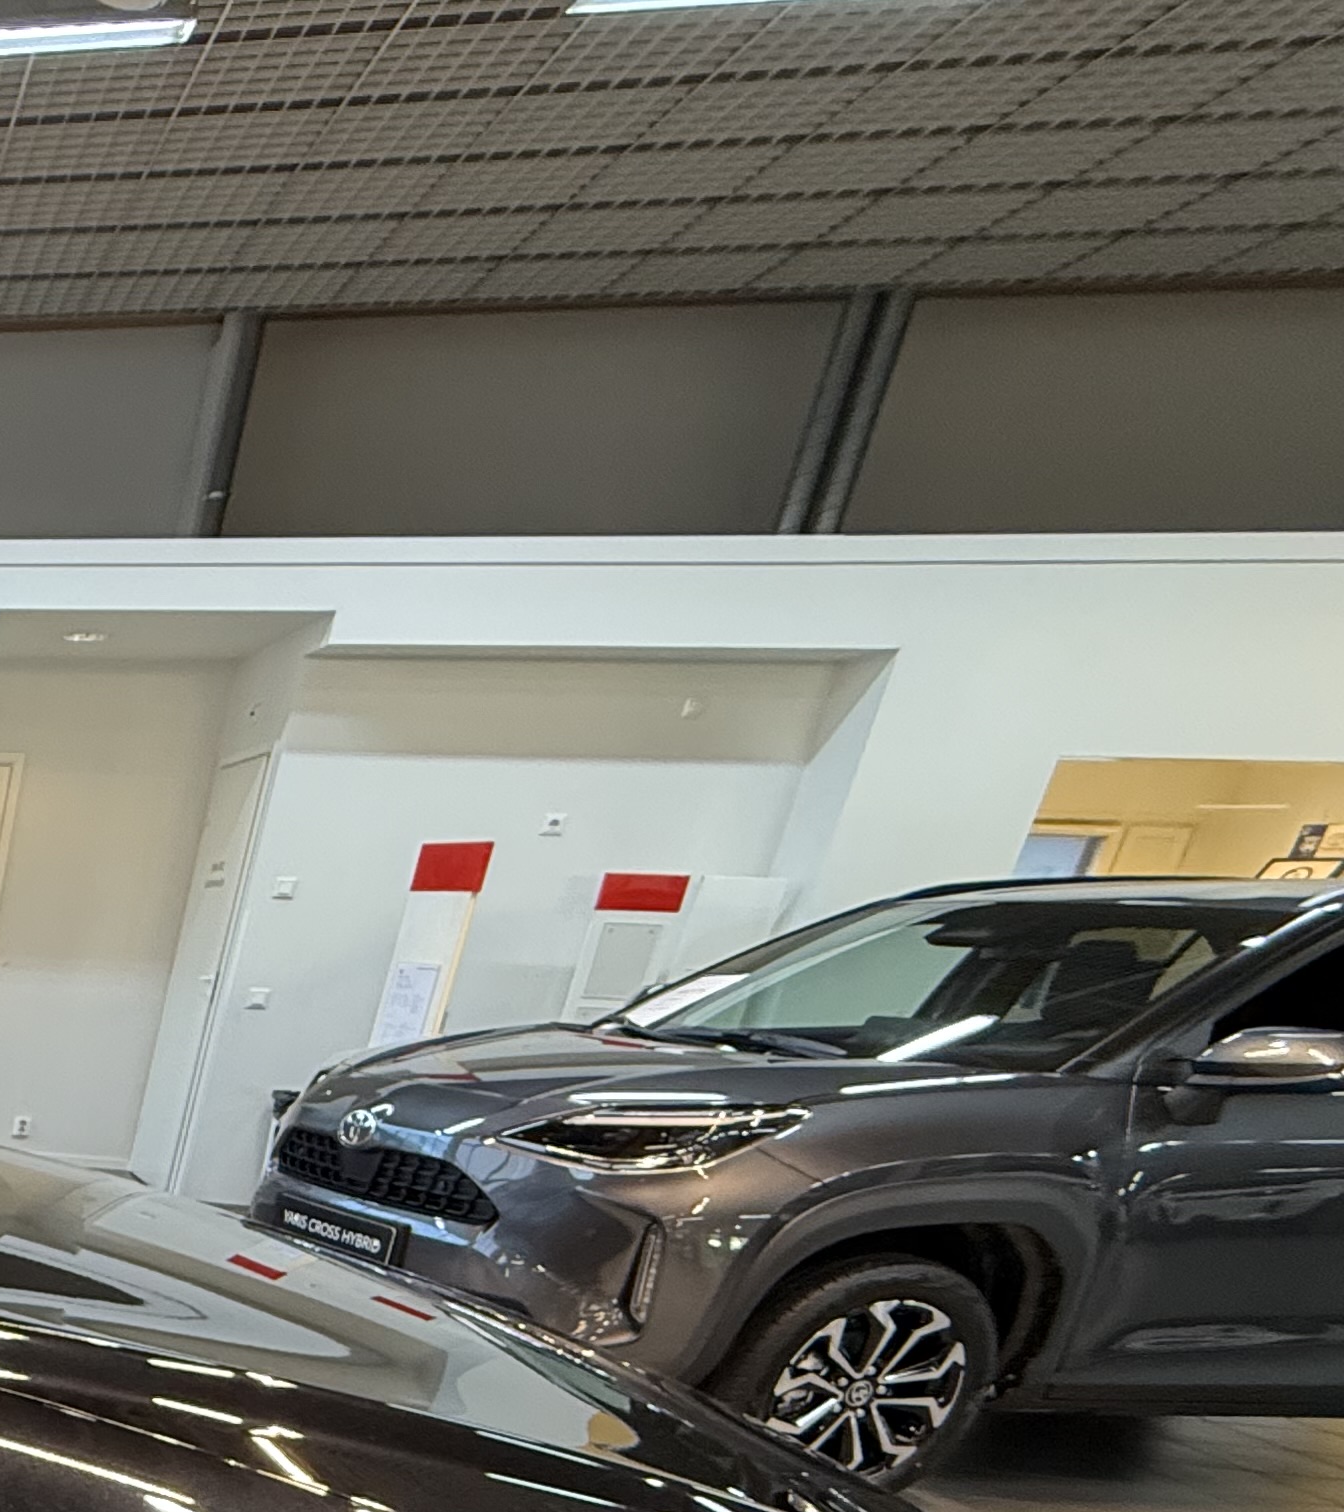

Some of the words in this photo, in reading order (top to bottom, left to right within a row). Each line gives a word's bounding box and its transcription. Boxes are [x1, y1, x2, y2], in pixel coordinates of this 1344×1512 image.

[284, 1208, 308, 1230] YARIS
[308, 1218, 341, 1241] CROSS
[341, 1229, 382, 1254] HYBRID
